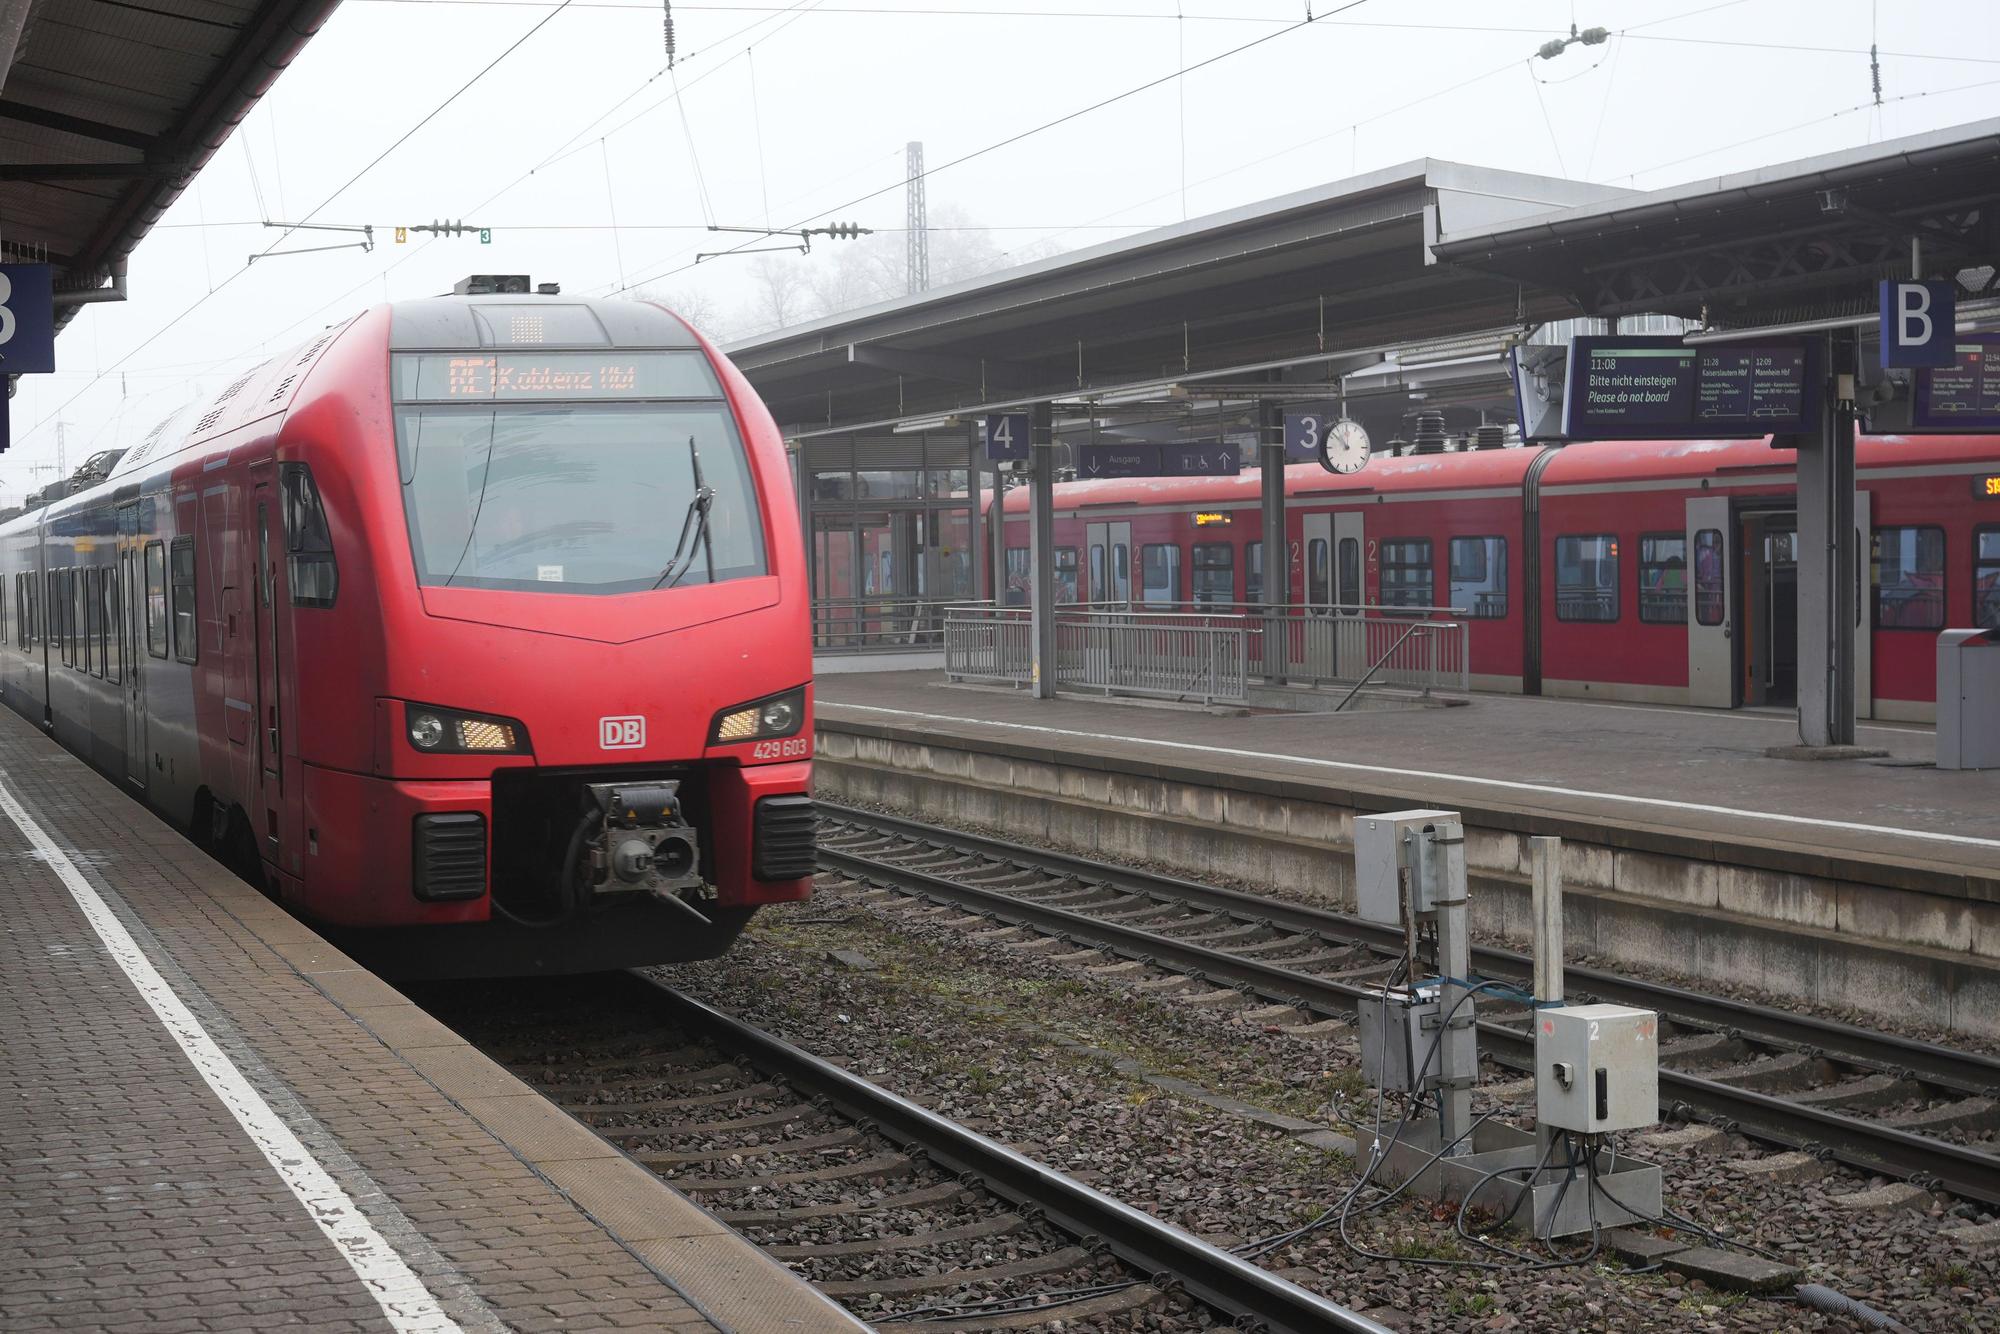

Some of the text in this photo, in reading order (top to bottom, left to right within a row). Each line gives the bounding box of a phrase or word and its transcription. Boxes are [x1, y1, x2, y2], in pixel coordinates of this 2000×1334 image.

[482, 230, 490, 242] 3
[1898, 284, 1932, 346] B
[1591, 359, 1616, 370] 11:08
[1756, 358, 1772, 366] 12:09
[1589, 374, 1677, 388] Bitte nicht einsteigen
[1755, 368, 1780, 377] Mannheim
[1588, 391, 1670, 403] Please do not board
[993, 416, 1013, 448] 4
[1300, 416, 1318, 449] 3
[1108, 455, 1141, 466] Ausgang
[1078, 547, 1084, 565] 2
[1134, 546, 1140, 564] 2
[1292, 542, 1299, 562] 2
[1368, 540, 1376, 562] 2
[605, 721, 642, 745] DB
[753, 739, 807, 760] 429 603
[1590, 1021, 1600, 1041] 2
